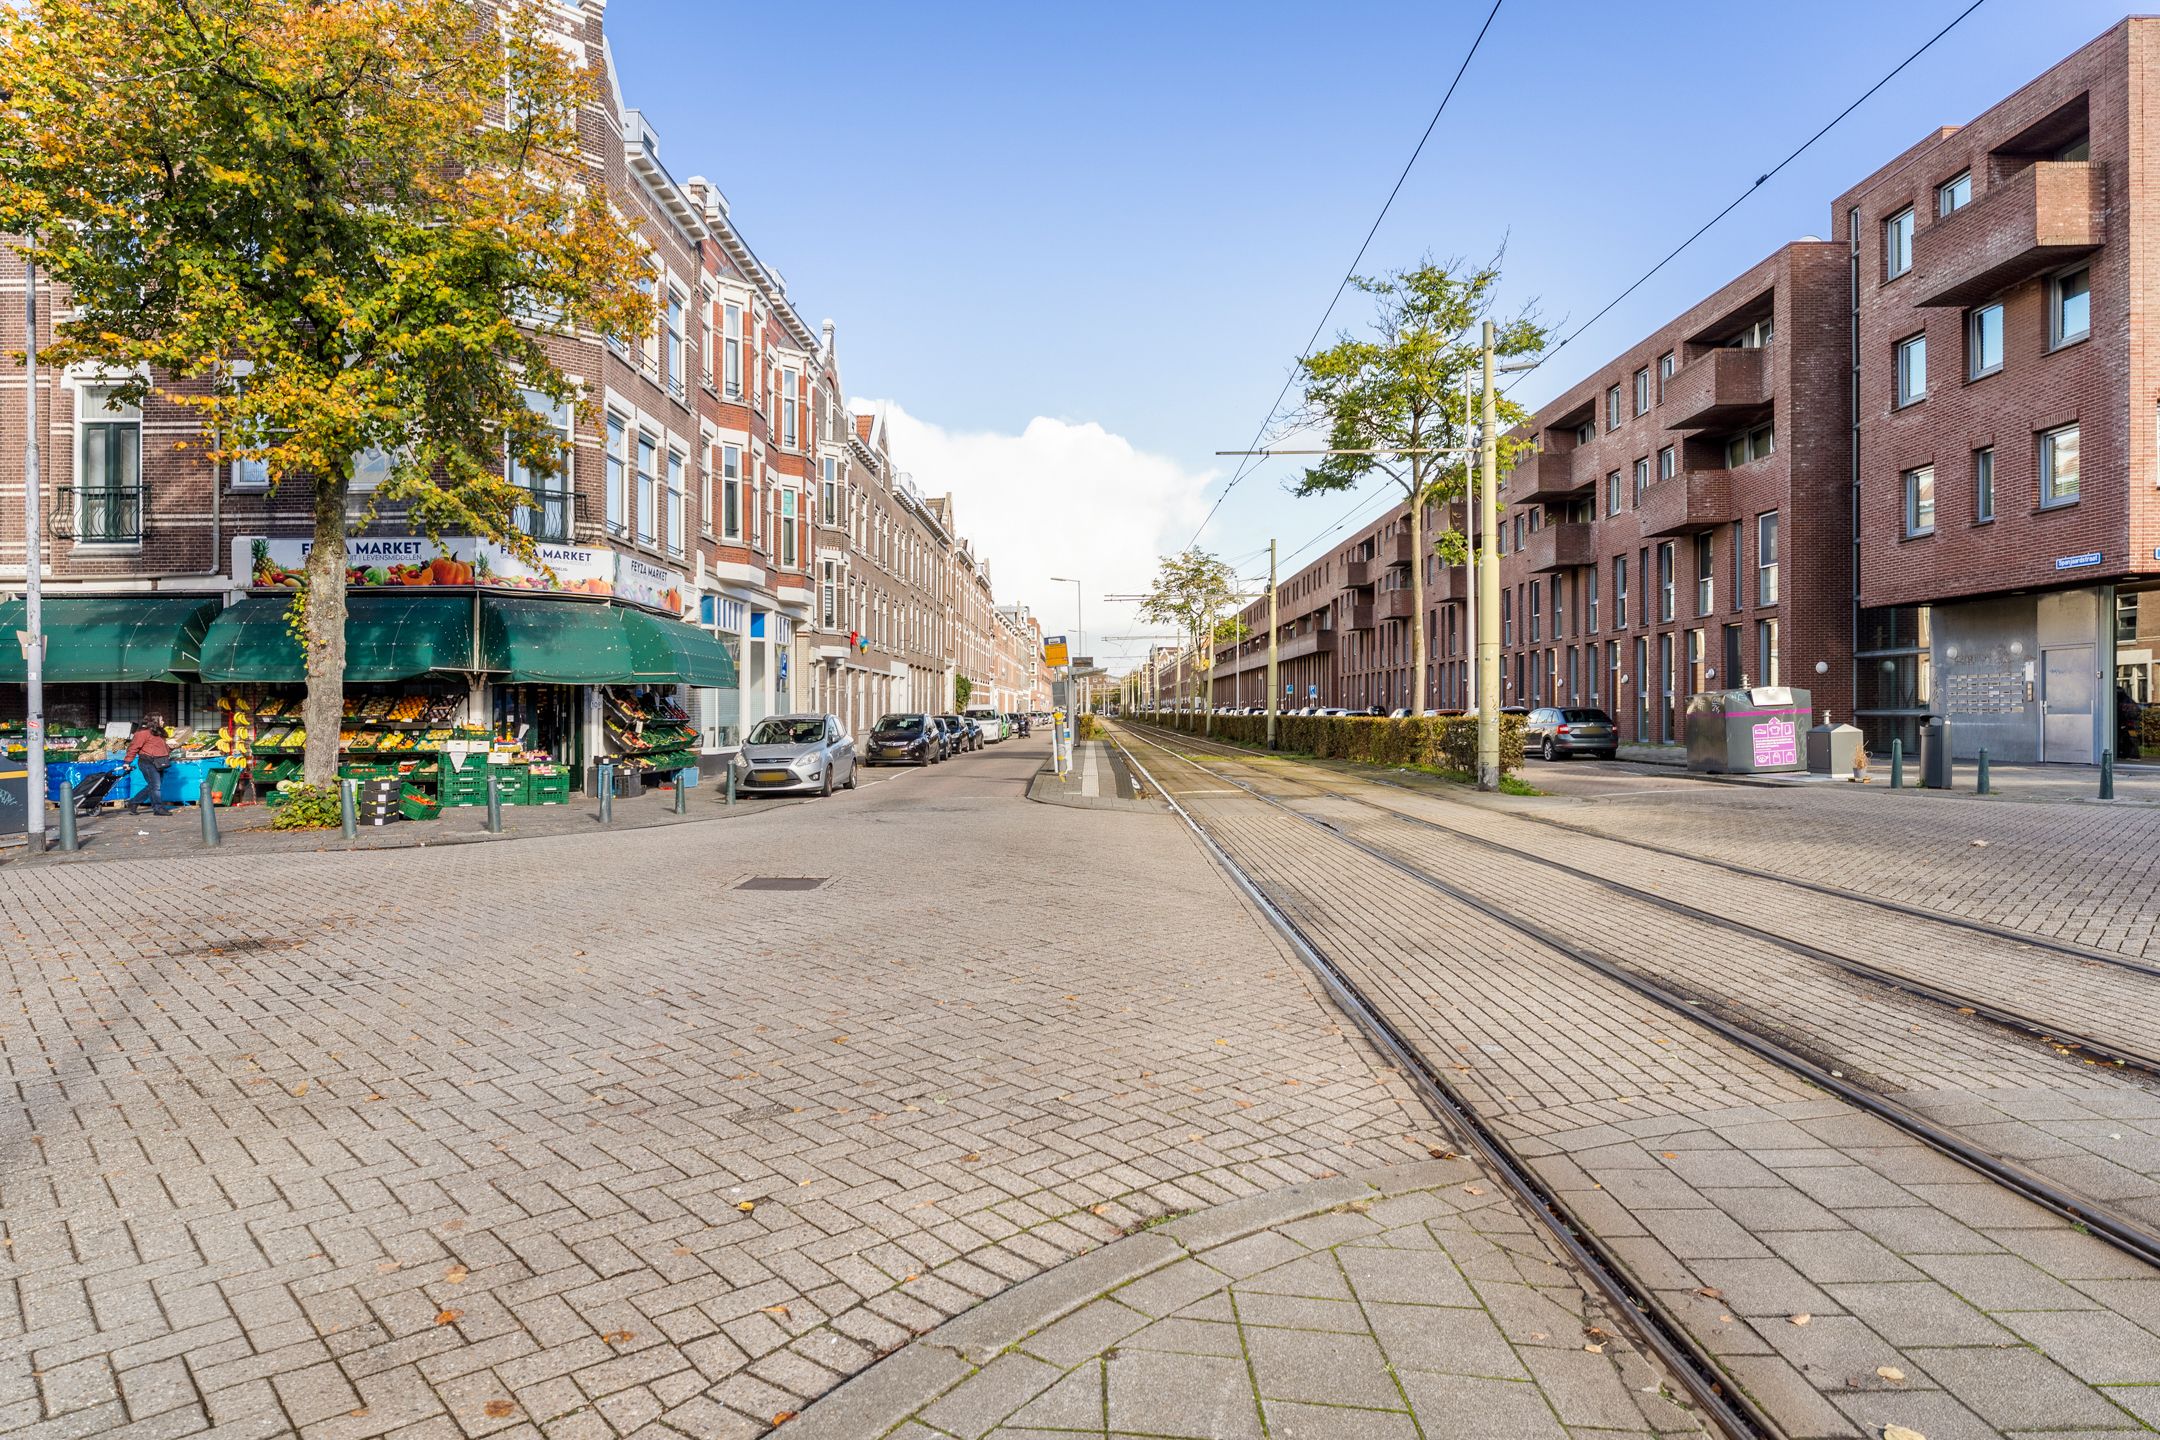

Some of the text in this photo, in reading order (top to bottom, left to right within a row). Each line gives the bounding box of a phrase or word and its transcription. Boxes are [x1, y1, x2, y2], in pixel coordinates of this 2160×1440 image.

[356, 542, 421, 554] MARKET
[543, 548, 592, 562] MARKET
[631, 560, 647, 575] FEYZA
[648, 567, 668, 582] MARKET
